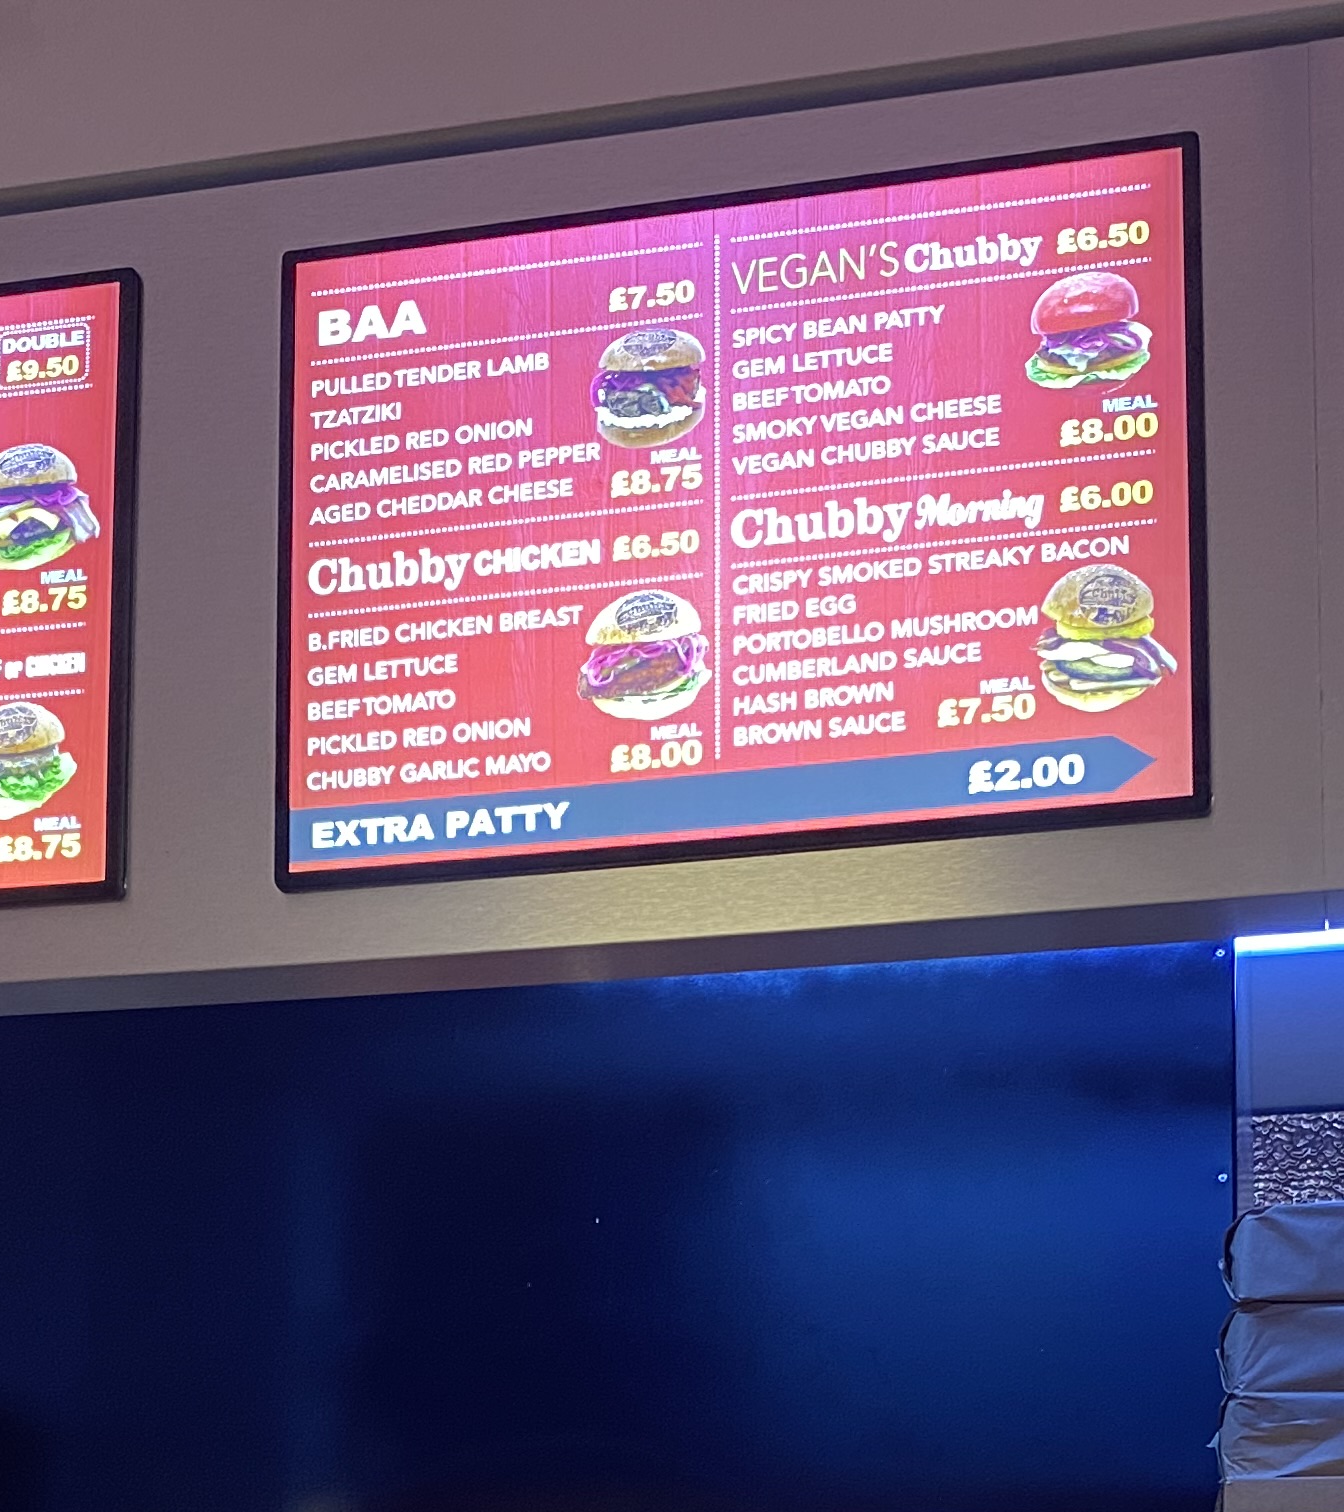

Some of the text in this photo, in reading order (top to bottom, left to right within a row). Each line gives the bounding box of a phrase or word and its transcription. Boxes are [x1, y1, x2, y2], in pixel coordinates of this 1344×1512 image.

[904, 233, 1043, 273] Chubby
[1057, 220, 1150, 255] £6.50
[318, 280, 695, 346] BAA £7.50
[6, 355, 79, 383] £9.50
[310, 402, 402, 429] TZATZIKI
[1059, 412, 1158, 447] £8.00
[311, 418, 533, 461] PICKLED RED ONION
[732, 427, 1000, 475] VEGAN CHUBBY SAUCE
[310, 442, 600, 493] CARAMELISED RED PEPPER
[611, 463, 703, 498] £8.75
[731, 480, 1153, 549] Chubby Morning £6.00
[308, 529, 700, 595] Chubby CHICKEN £6.50
[1, 585, 87, 616] £8.75
[733, 593, 856, 625] FRIED EGG
[308, 605, 583, 652] B.FRIED CHICKEN BREAST
[938, 693, 1036, 728] £7.50
[611, 738, 702, 773] £8.00
[313, 754, 1085, 848] EXTRA PATTY £2.00
